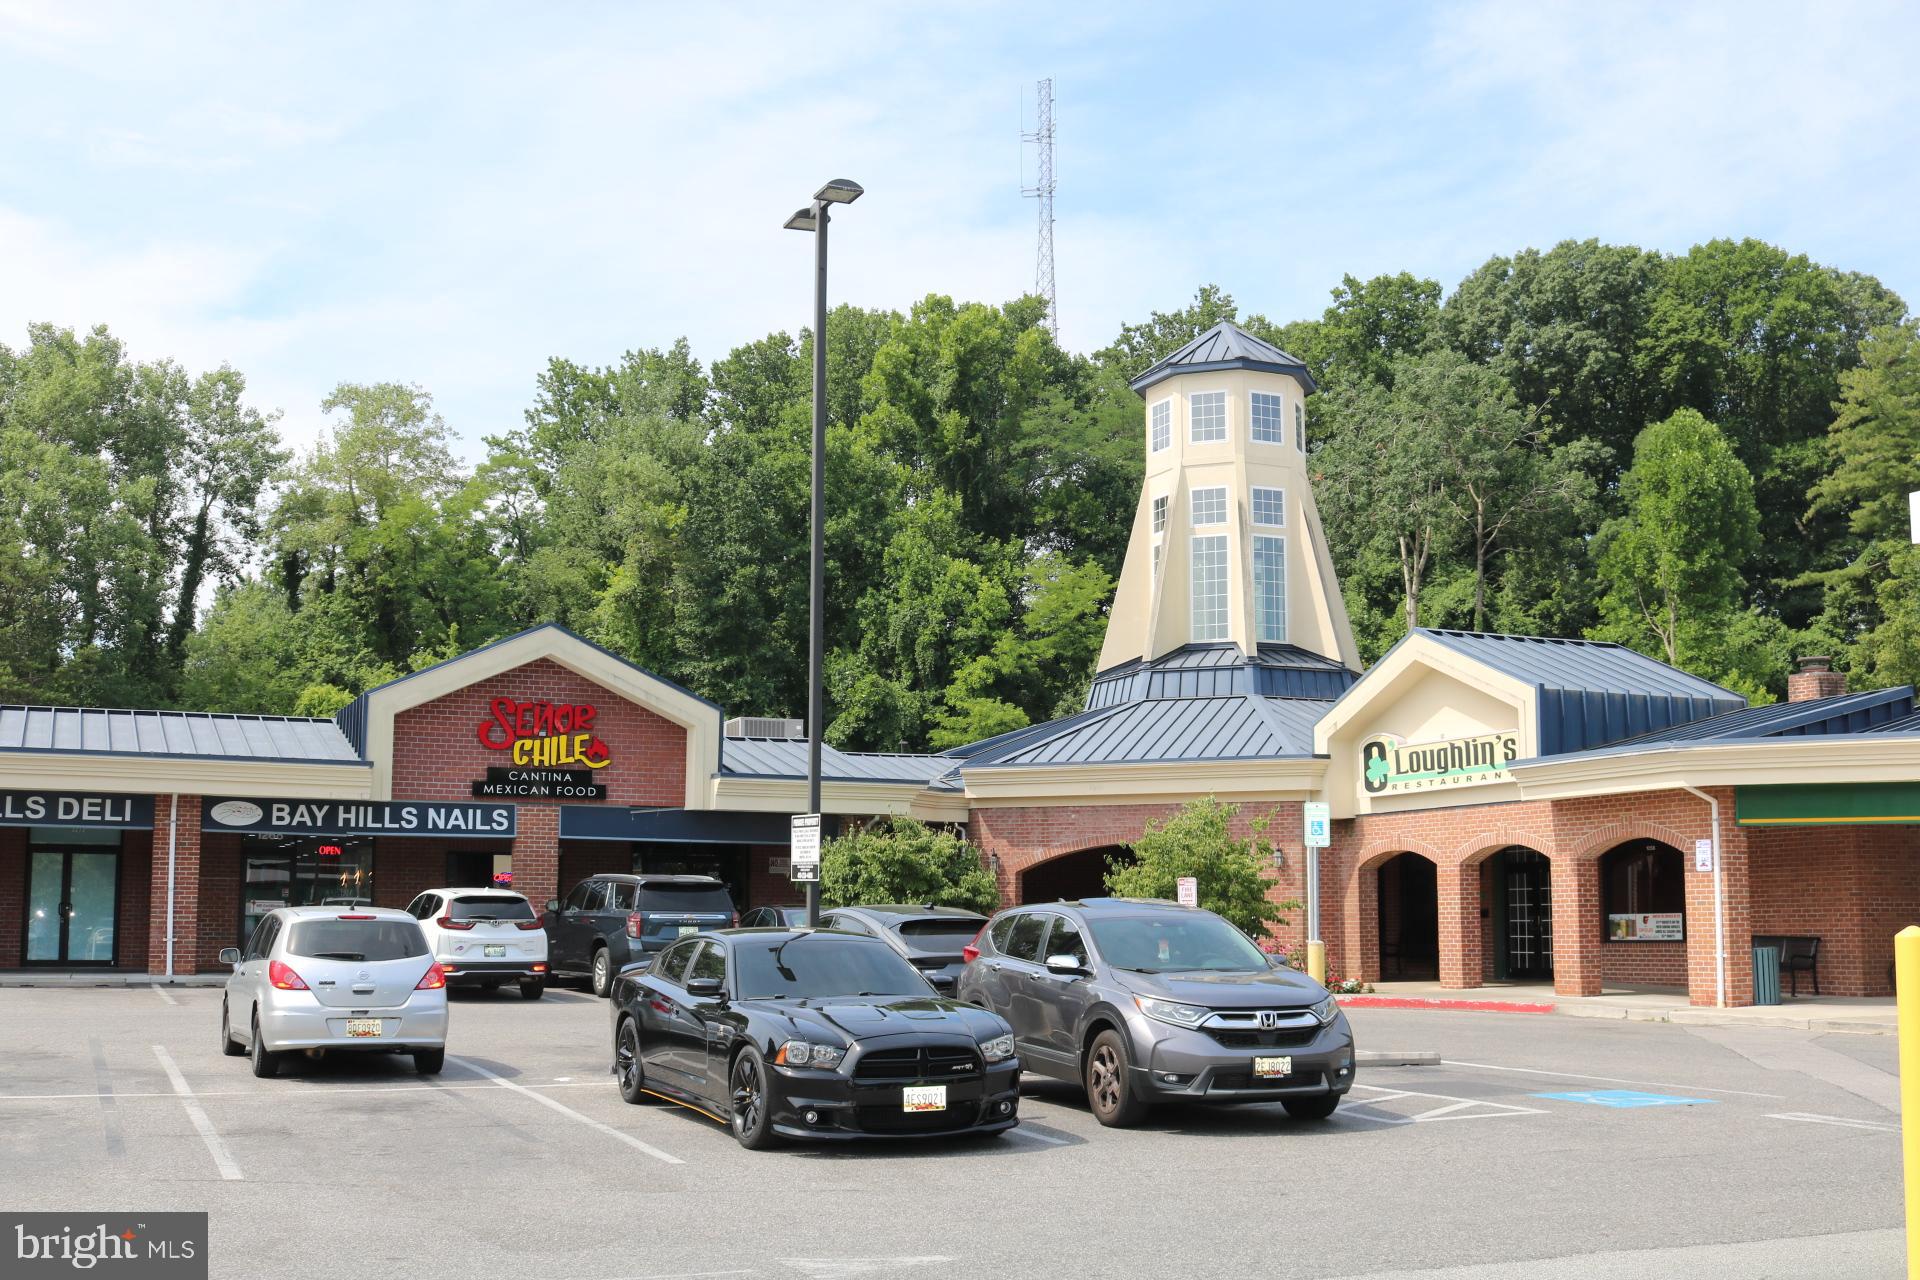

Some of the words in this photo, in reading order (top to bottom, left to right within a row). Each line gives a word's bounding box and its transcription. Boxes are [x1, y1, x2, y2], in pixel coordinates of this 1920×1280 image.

[513, 733, 611, 769] CHILE
[508, 771, 573, 782] CANTINA
[1391, 770, 1514, 791] RESTAURAN
[483, 784, 549, 796] MEXICAN
[556, 786, 597, 796] FOOD
[0, 795, 46, 819] LS
[57, 797, 132, 822] DELI
[271, 803, 332, 827] BAY
[338, 805, 418, 829] HILLS
[427, 808, 509, 831] NAILS
[319, 845, 341, 855] OPEN
